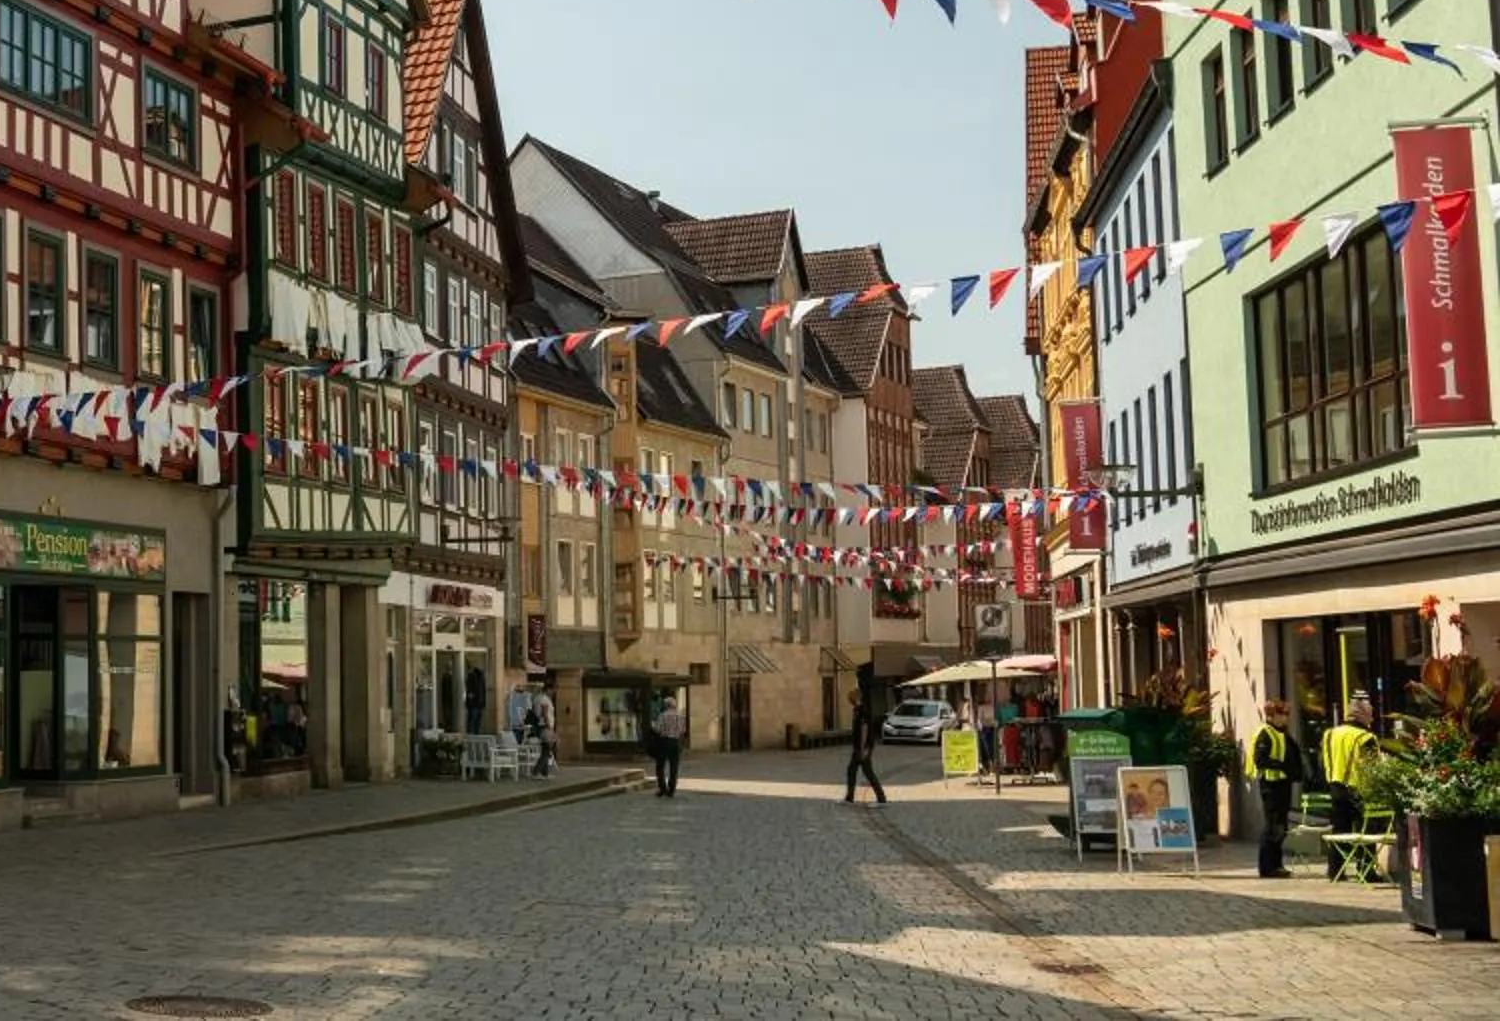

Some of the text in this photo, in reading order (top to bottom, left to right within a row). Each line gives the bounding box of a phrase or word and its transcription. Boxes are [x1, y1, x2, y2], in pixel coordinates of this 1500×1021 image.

[1421, 156, 1453, 311] Schmalkden
[1338, 470, 1421, 517] Schmalkalden
[27, 523, 87, 556] Pension
[1023, 519, 1036, 594] MODEHAUS
